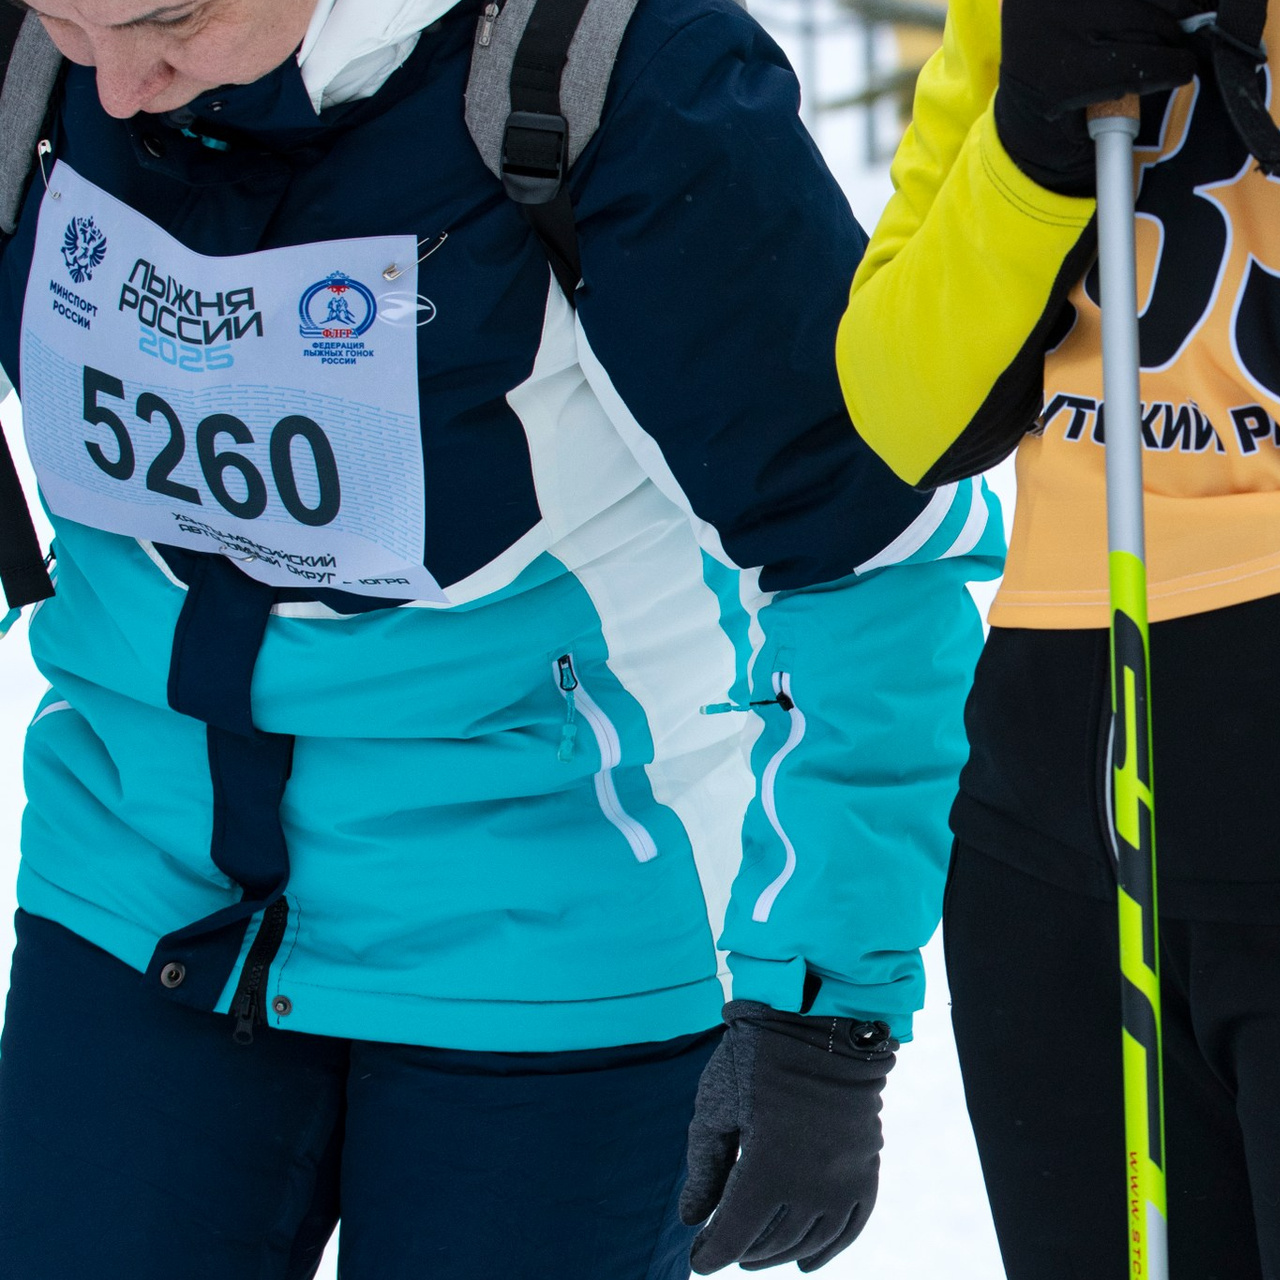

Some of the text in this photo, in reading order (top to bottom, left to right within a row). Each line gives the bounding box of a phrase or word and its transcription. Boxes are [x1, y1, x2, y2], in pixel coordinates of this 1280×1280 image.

[50, 279, 98, 318] МИНСПОРТ
[128, 258, 255, 317] ЛЫЖНЯ
[53, 300, 91, 330] РОССИИ
[118, 282, 263, 345] РОССИИ
[138, 325, 235, 373] 2025
[303, 349, 343, 357] ЛЫЖНЫХ
[312, 342, 365, 350] ФЕДЕРАЦИЯ
[321, 357, 357, 365] РОССИИ
[83, 365, 341, 527] 5260
[286, 563, 336, 584] ОКРУГ
[359, 577, 410, 585] ЮГРА
